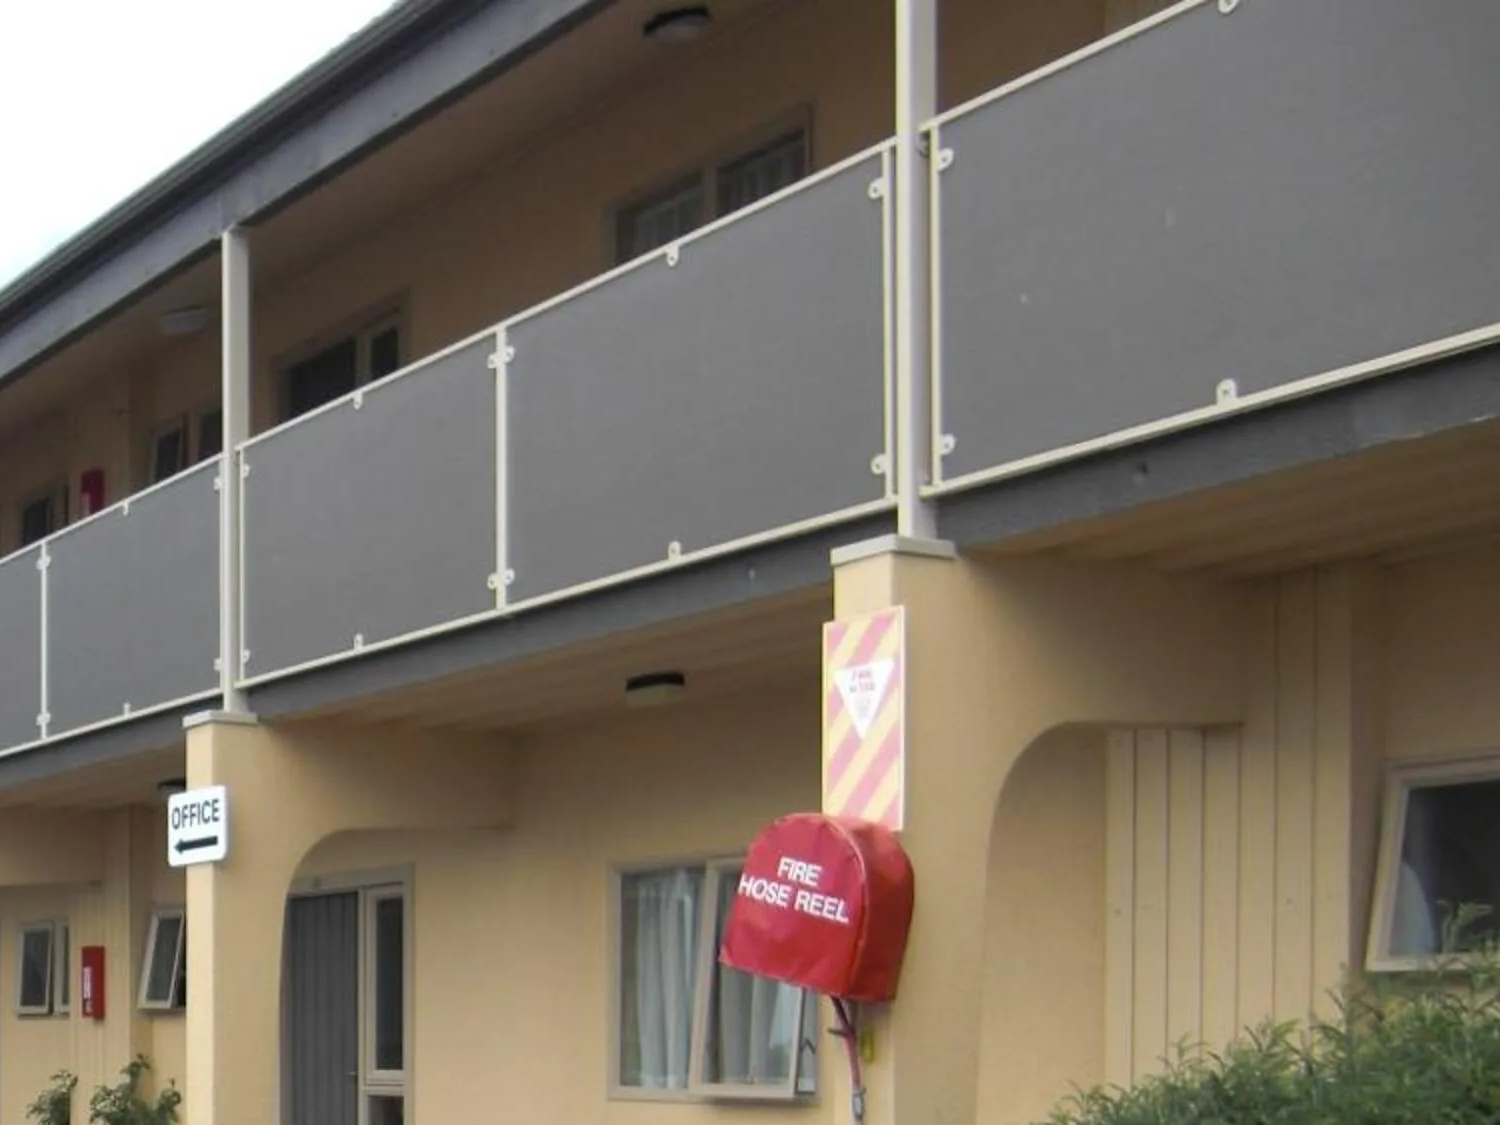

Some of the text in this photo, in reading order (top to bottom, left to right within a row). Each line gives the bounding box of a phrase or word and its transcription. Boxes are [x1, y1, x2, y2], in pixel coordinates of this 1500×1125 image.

[171, 798, 220, 830] OFFICE
[777, 856, 823, 887] FIRE
[737, 873, 850, 924] HOSE REEL
